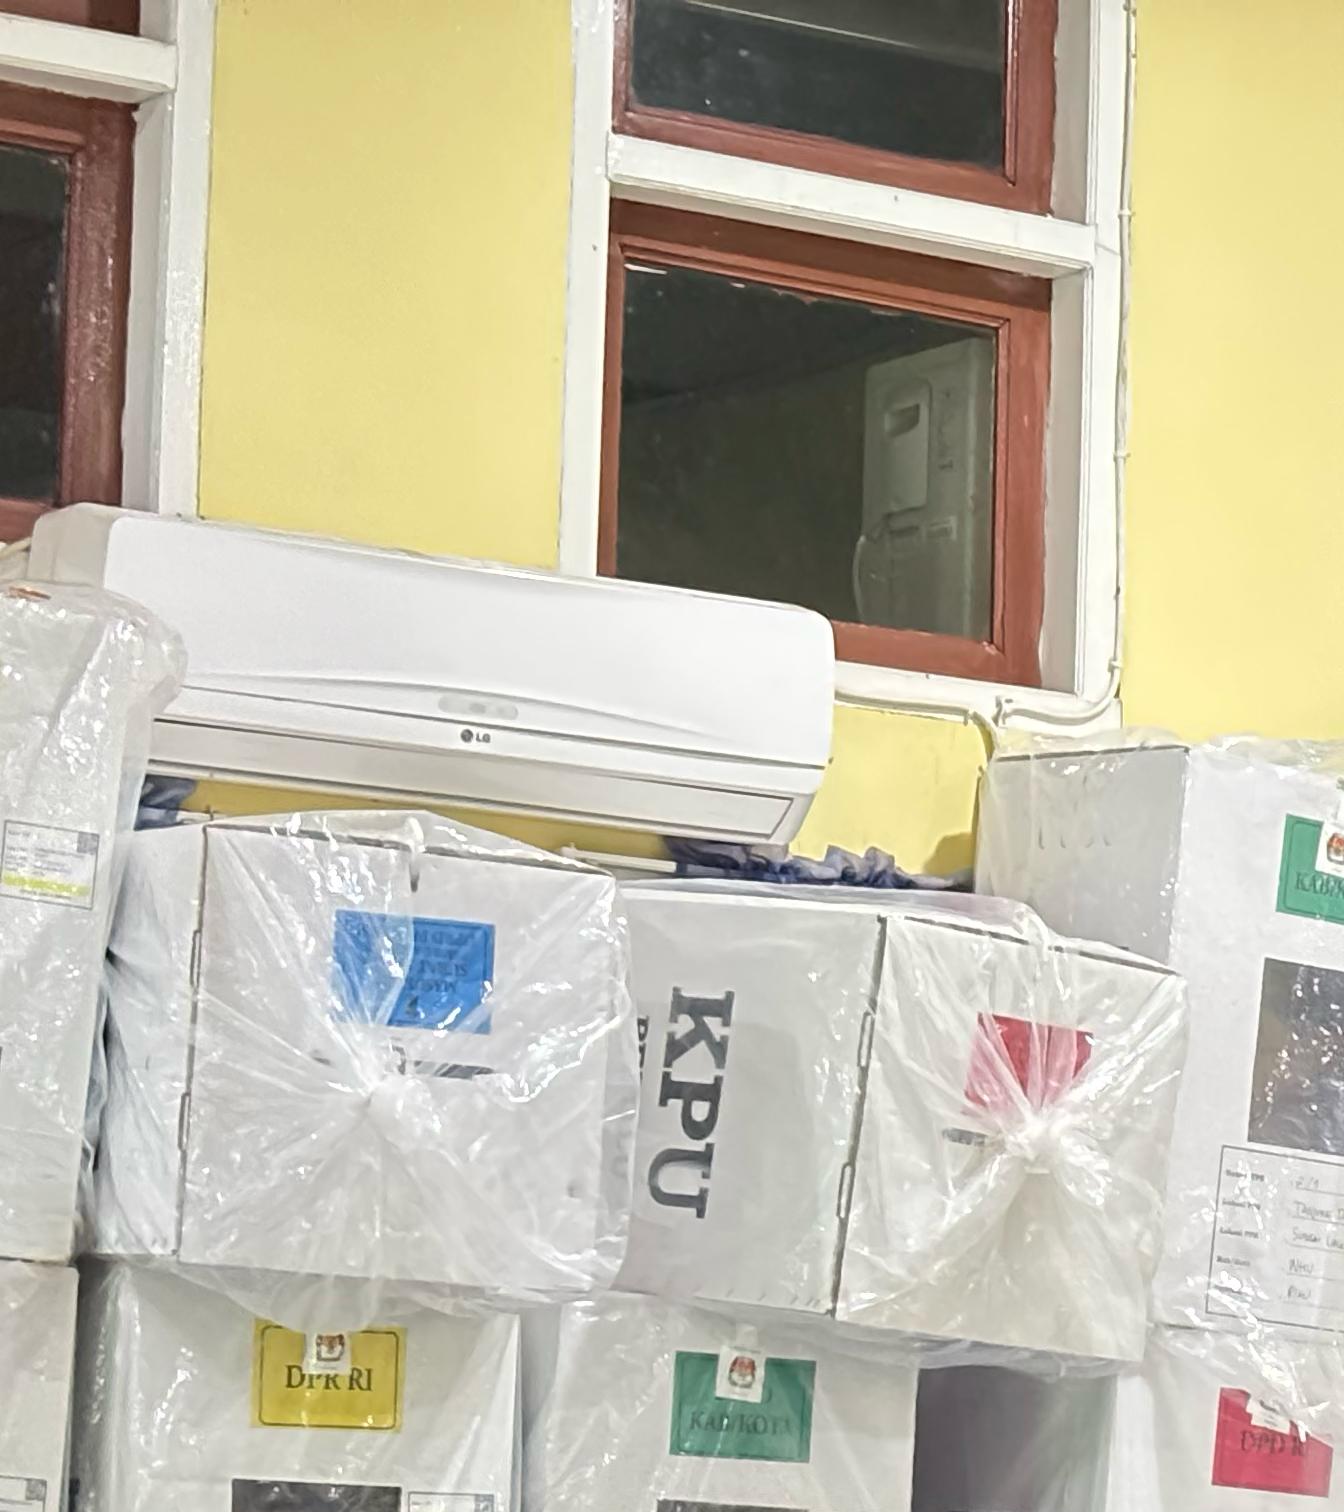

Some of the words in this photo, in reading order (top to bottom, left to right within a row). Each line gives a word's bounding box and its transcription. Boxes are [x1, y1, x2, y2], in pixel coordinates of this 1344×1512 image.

[648, 986, 735, 1220] KPU
[285, 1364, 341, 1390] DPR
[348, 1367, 374, 1392] RI
